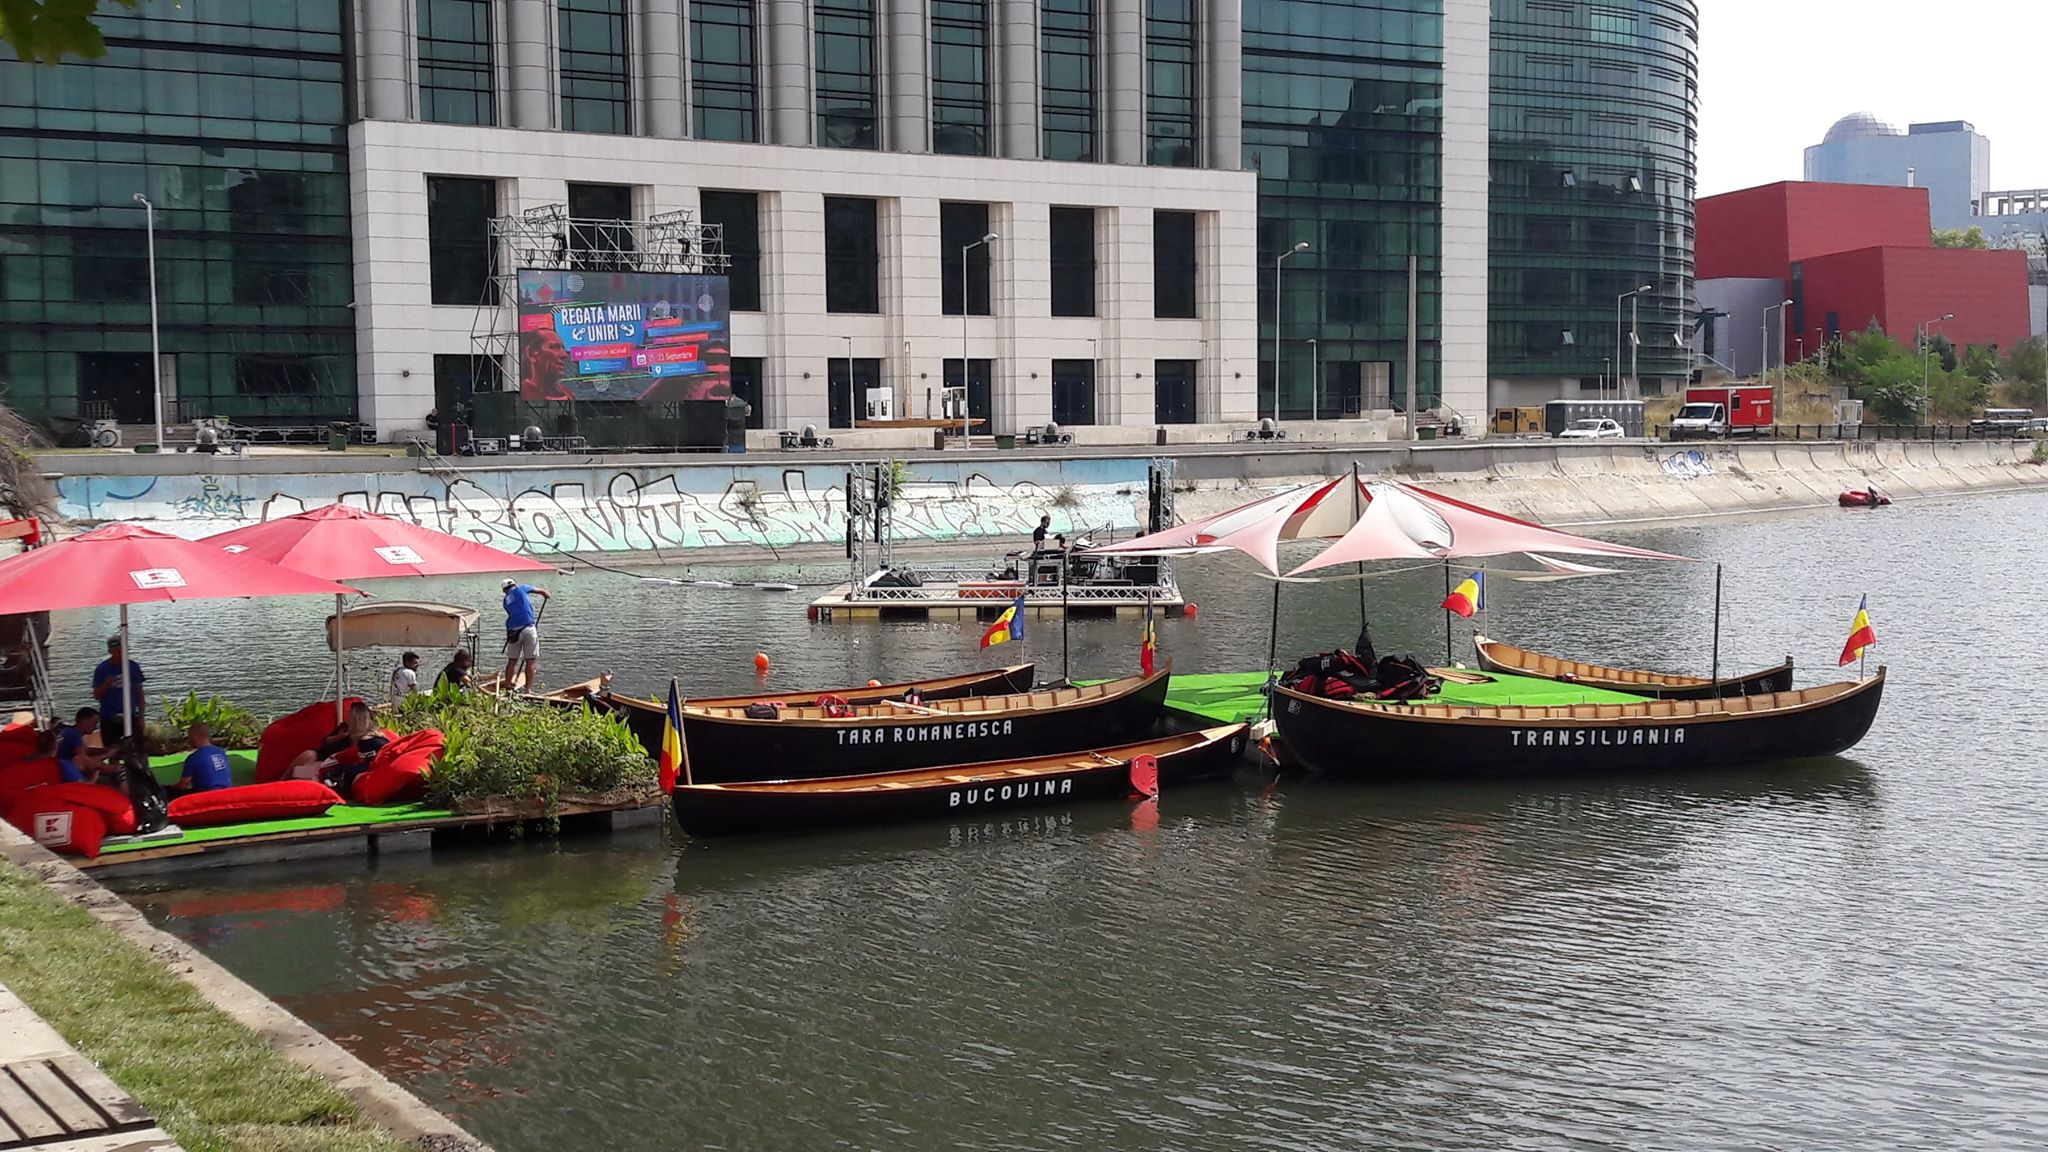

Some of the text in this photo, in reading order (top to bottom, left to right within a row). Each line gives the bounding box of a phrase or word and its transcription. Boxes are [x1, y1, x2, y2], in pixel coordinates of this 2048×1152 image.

[561, 303, 641, 325] REGATA MARII
[587, 324, 619, 342] UNIRI
[837, 720, 1013, 745] TARA ROMANEASCA
[1511, 728, 1685, 746] TRANSILVANIA
[949, 778, 1073, 807] BUCOVINA
